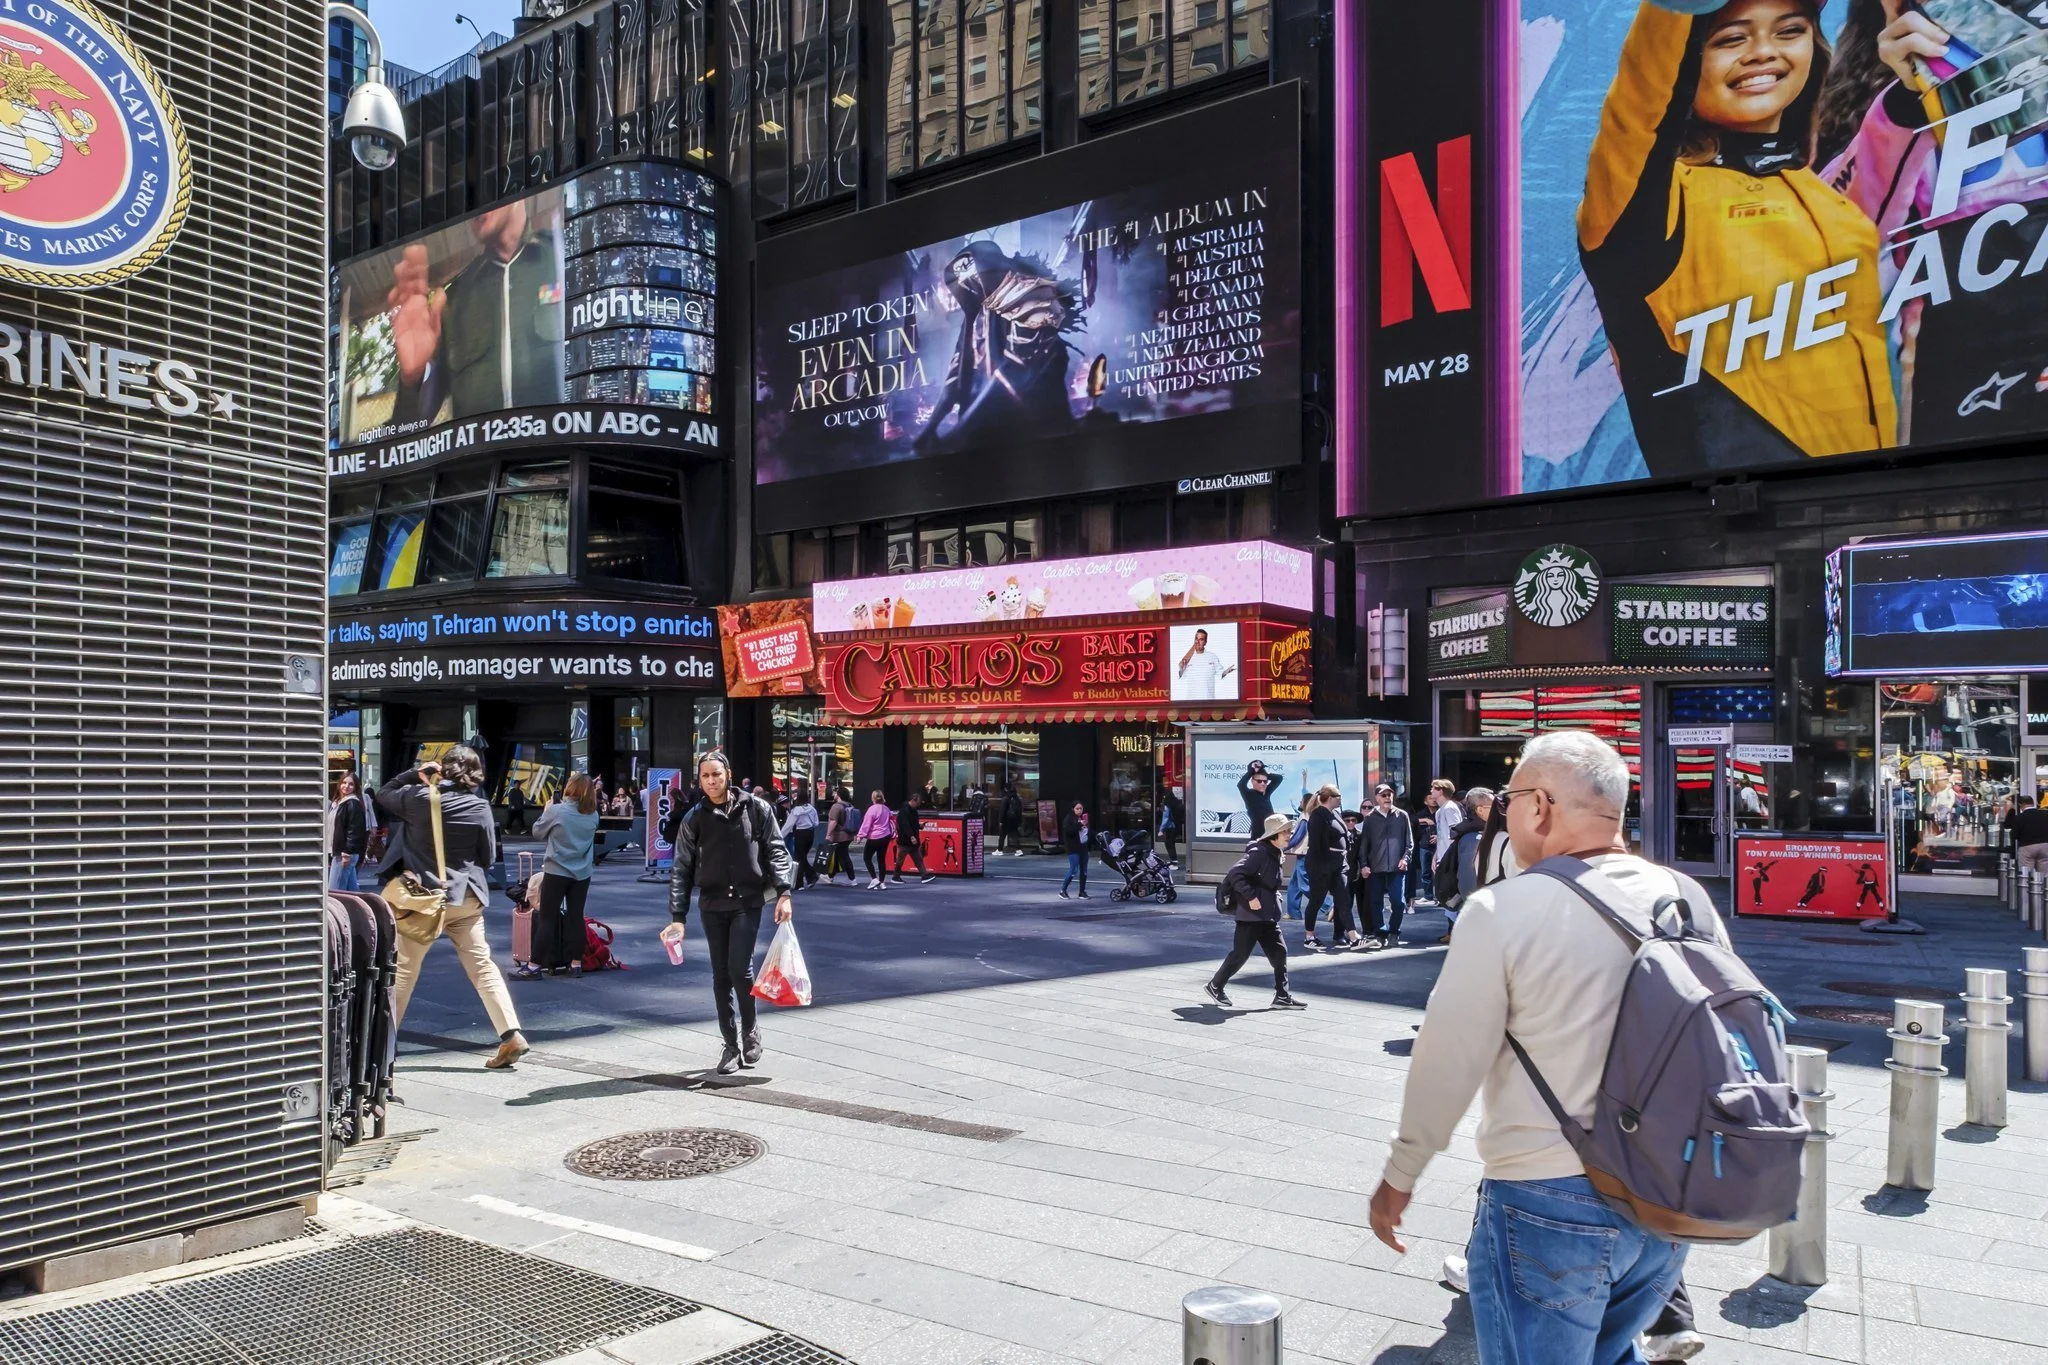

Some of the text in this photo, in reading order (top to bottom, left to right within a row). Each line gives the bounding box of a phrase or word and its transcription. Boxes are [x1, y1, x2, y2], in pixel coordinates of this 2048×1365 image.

[27, 3, 59, 27] OF
[65, 22, 110, 65] THE
[108, 70, 160, 148] NAVY
[0, 170, 158, 255] ES MARINE CORPS
[1074, 187, 1268, 255] THE #1 ALBUM IN
[1157, 219, 1264, 256] #1 AUSTRALIA
[1177, 237, 1264, 268] #1 AUSTRIA
[1170, 255, 1264, 287] #1 BELGIUM
[1177, 273, 1264, 302] #1 CANADA
[572, 287, 703, 330] nightline
[788, 290, 929, 343] SLEEP TOKEN
[1158, 290, 1264, 324] #1 GERMANY
[1141, 310, 1261, 346] NETHERLANDS
[1653, 258, 1858, 396] THE
[800, 324, 917, 378] EVEN IN
[1143, 342, 1177, 362] NEW
[1183, 327, 1262, 355] ZEALAND
[1114, 362, 1171, 384] UNITED
[1175, 345, 1265, 373] KINGDOM
[1136, 375, 1195, 397] UNITED
[1197, 363, 1262, 386] STATES
[1384, 353, 1470, 387] MAY 28
[789, 358, 930, 413] ARCADIA
[358, 418, 428, 444] nightline always on
[824, 411, 854, 427] OUT
[329, 452, 367, 477] LINE
[380, 429, 454, 469] LATENIGHT
[455, 423, 478, 448] AT
[482, 415, 547, 443] 12:35a
[552, 411, 592, 435] ON
[598, 411, 661, 436] ABC
[684, 421, 719, 448] AN
[940, 574, 963, 589] Cool
[1043, 563, 1081, 580] Carlo's
[1085, 560, 1112, 576] Cool
[339, 621, 375, 644] talks,
[379, 617, 429, 643] saying
[432, 614, 497, 636] Tehran
[503, 609, 569, 633] won't
[575, 611, 636, 638] stop
[644, 614, 713, 638] enrich
[1429, 607, 1505, 638] STARBUCKS
[1617, 600, 1767, 622] STARBUCKS
[759, 635, 778, 650] BEST
[779, 630, 799, 645] FAST
[1081, 631, 1155, 657] BAKE
[1440, 635, 1489, 659] COFFEE
[1642, 626, 1738, 647] COFFEE
[332, 654, 714, 682] admires single, manager wants to cha
[750, 643, 797, 663] FOOD FRIED
[832, 632, 1064, 716] CARLO'S
[1080, 659, 1155, 684] SHOP
[914, 689, 1022, 705] TIMES SQUARE
[1073, 691, 1086, 700] BY
[1088, 687, 1121, 700] Buddy
[1271, 683, 1311, 700] BAKE SHOP
[1785, 844, 1841, 853] BROADWAY'S
[1843, 853, 1884, 861] MUSICAL
